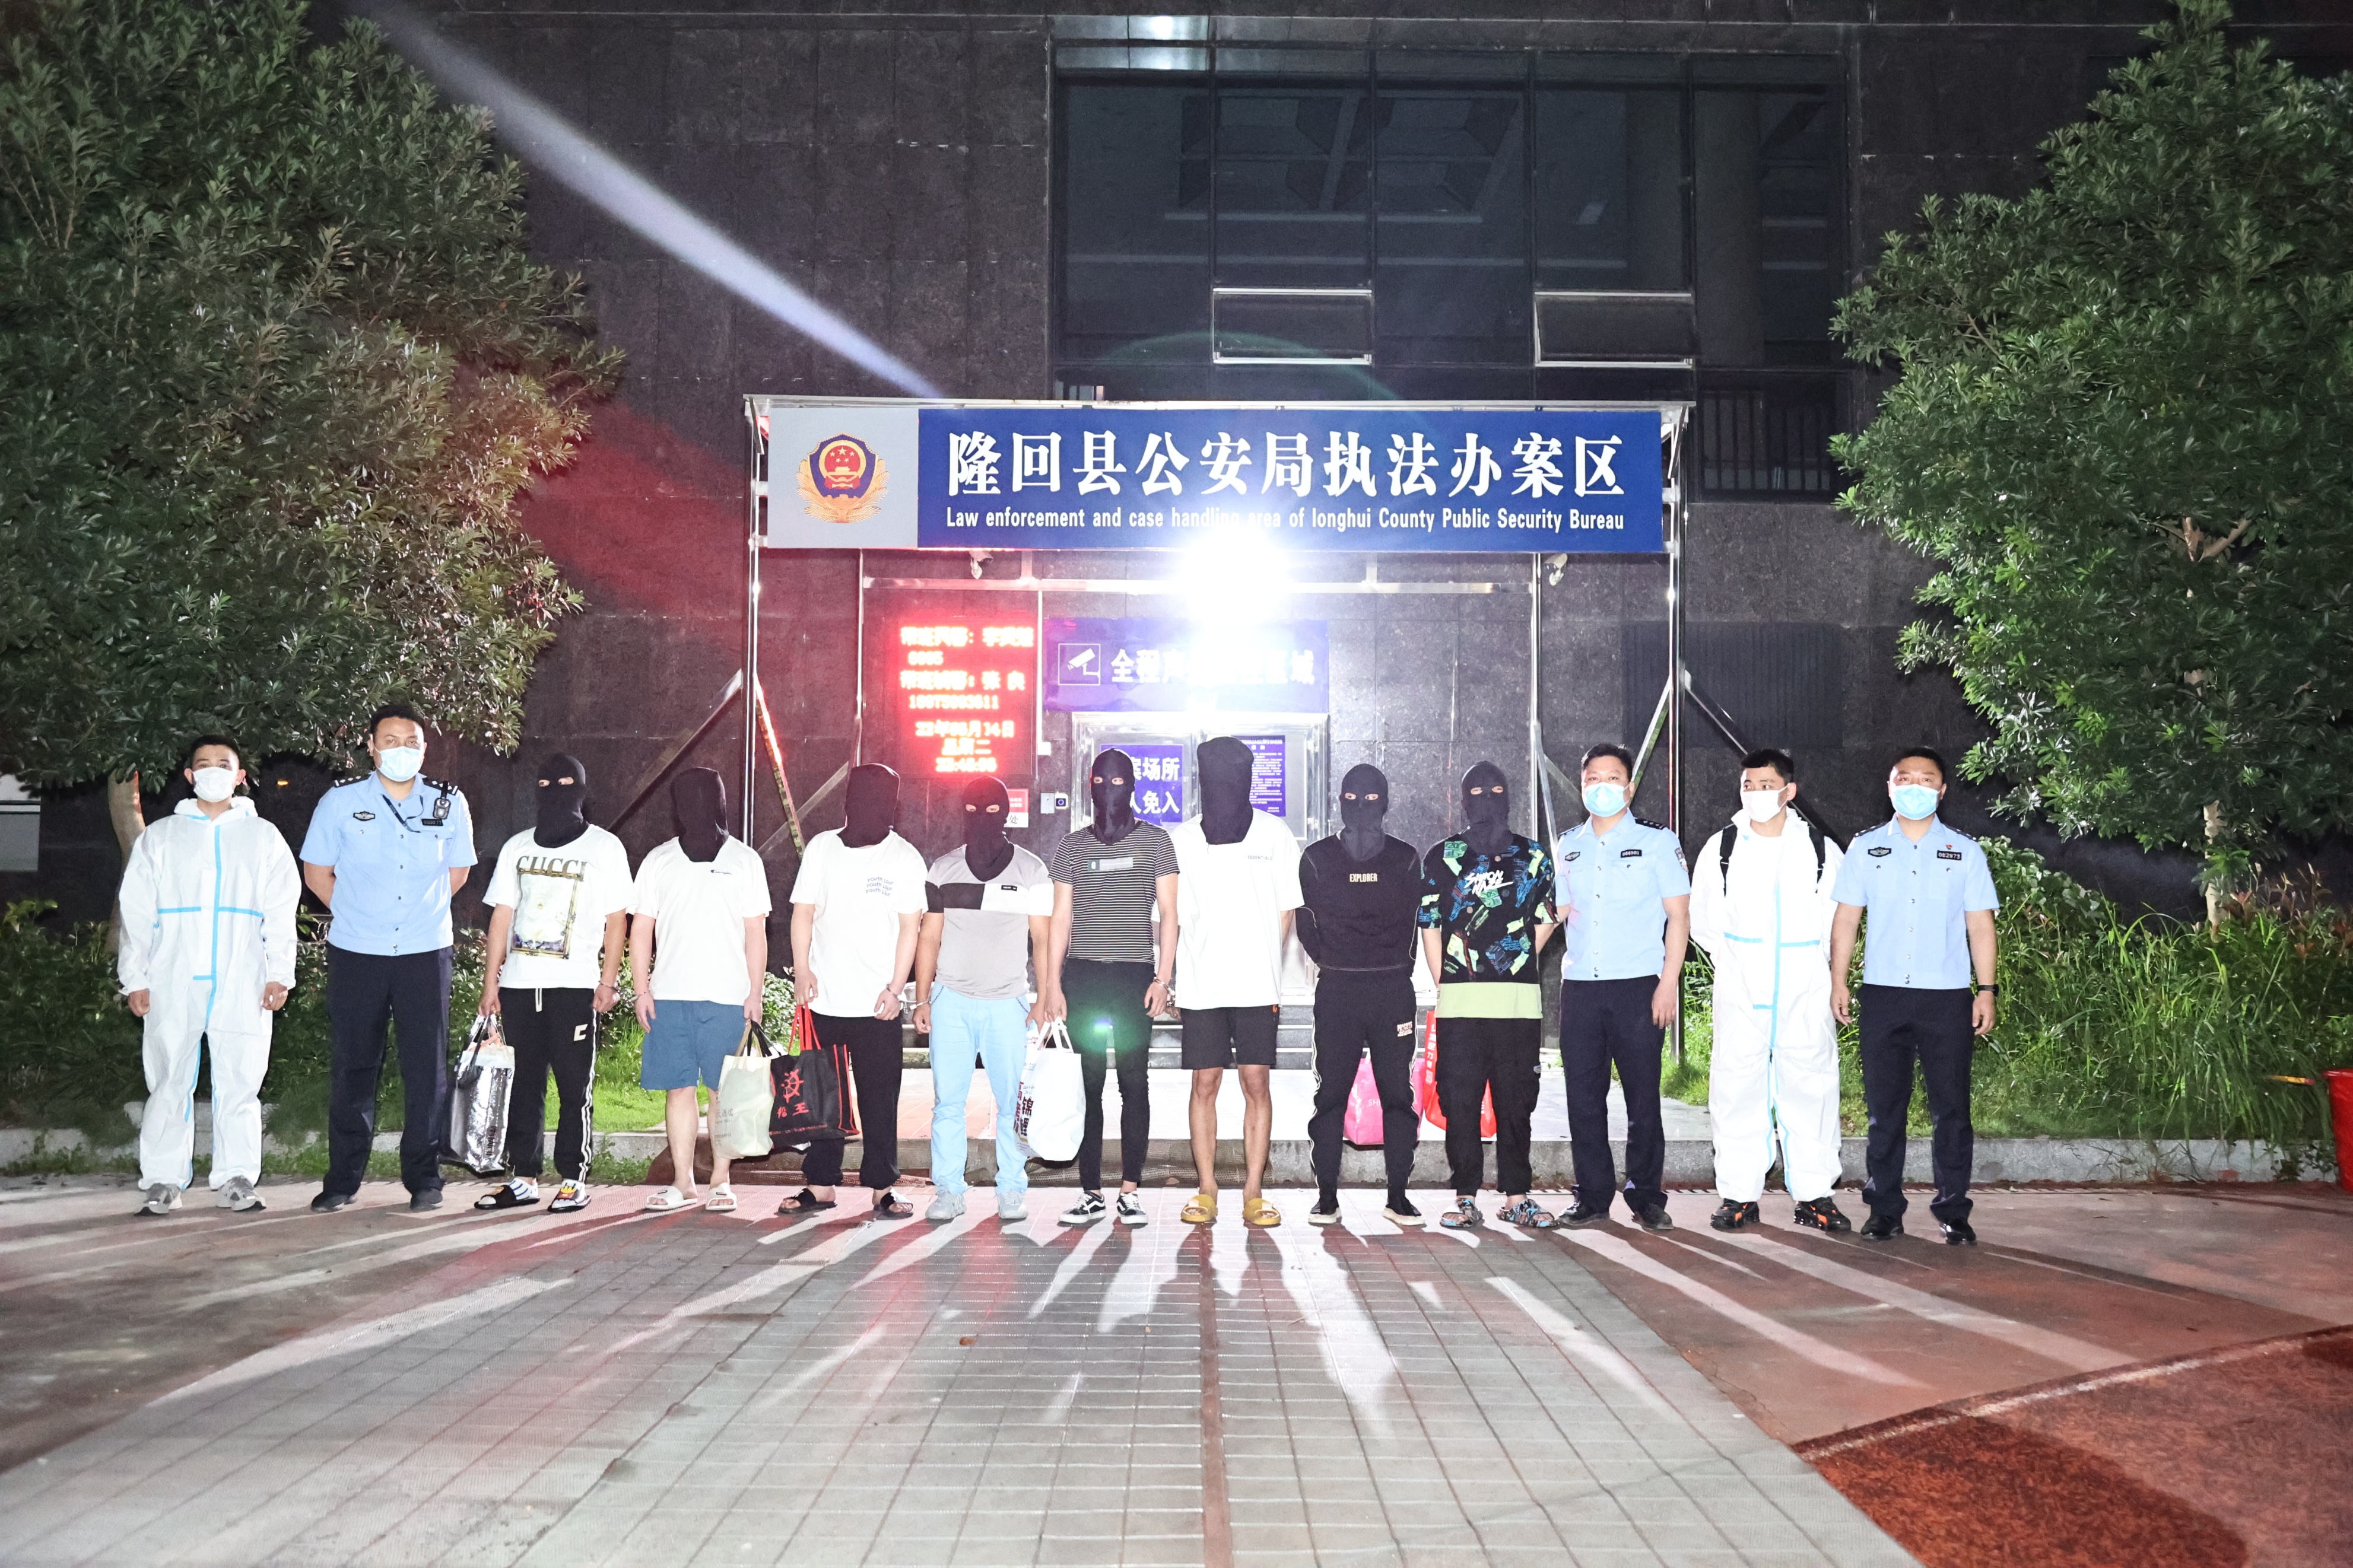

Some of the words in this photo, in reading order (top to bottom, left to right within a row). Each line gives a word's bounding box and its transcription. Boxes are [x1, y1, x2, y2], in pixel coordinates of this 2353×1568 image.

[949, 430, 1624, 498] 隆回县公安局执法办案区
[948, 507, 978, 527] Law
[986, 507, 1084, 527] enforcement
[1093, 507, 1121, 527] and
[1129, 512, 1164, 527] case
[1248, 513, 1281, 527] area
[1289, 507, 1305, 527] of
[1379, 508, 1434, 533] County
[1443, 508, 1490, 528] Public
[1498, 508, 1562, 533] Security
[1570, 510, 1624, 529] Bureau
[1349, 873, 1377, 883] EXPLORER
